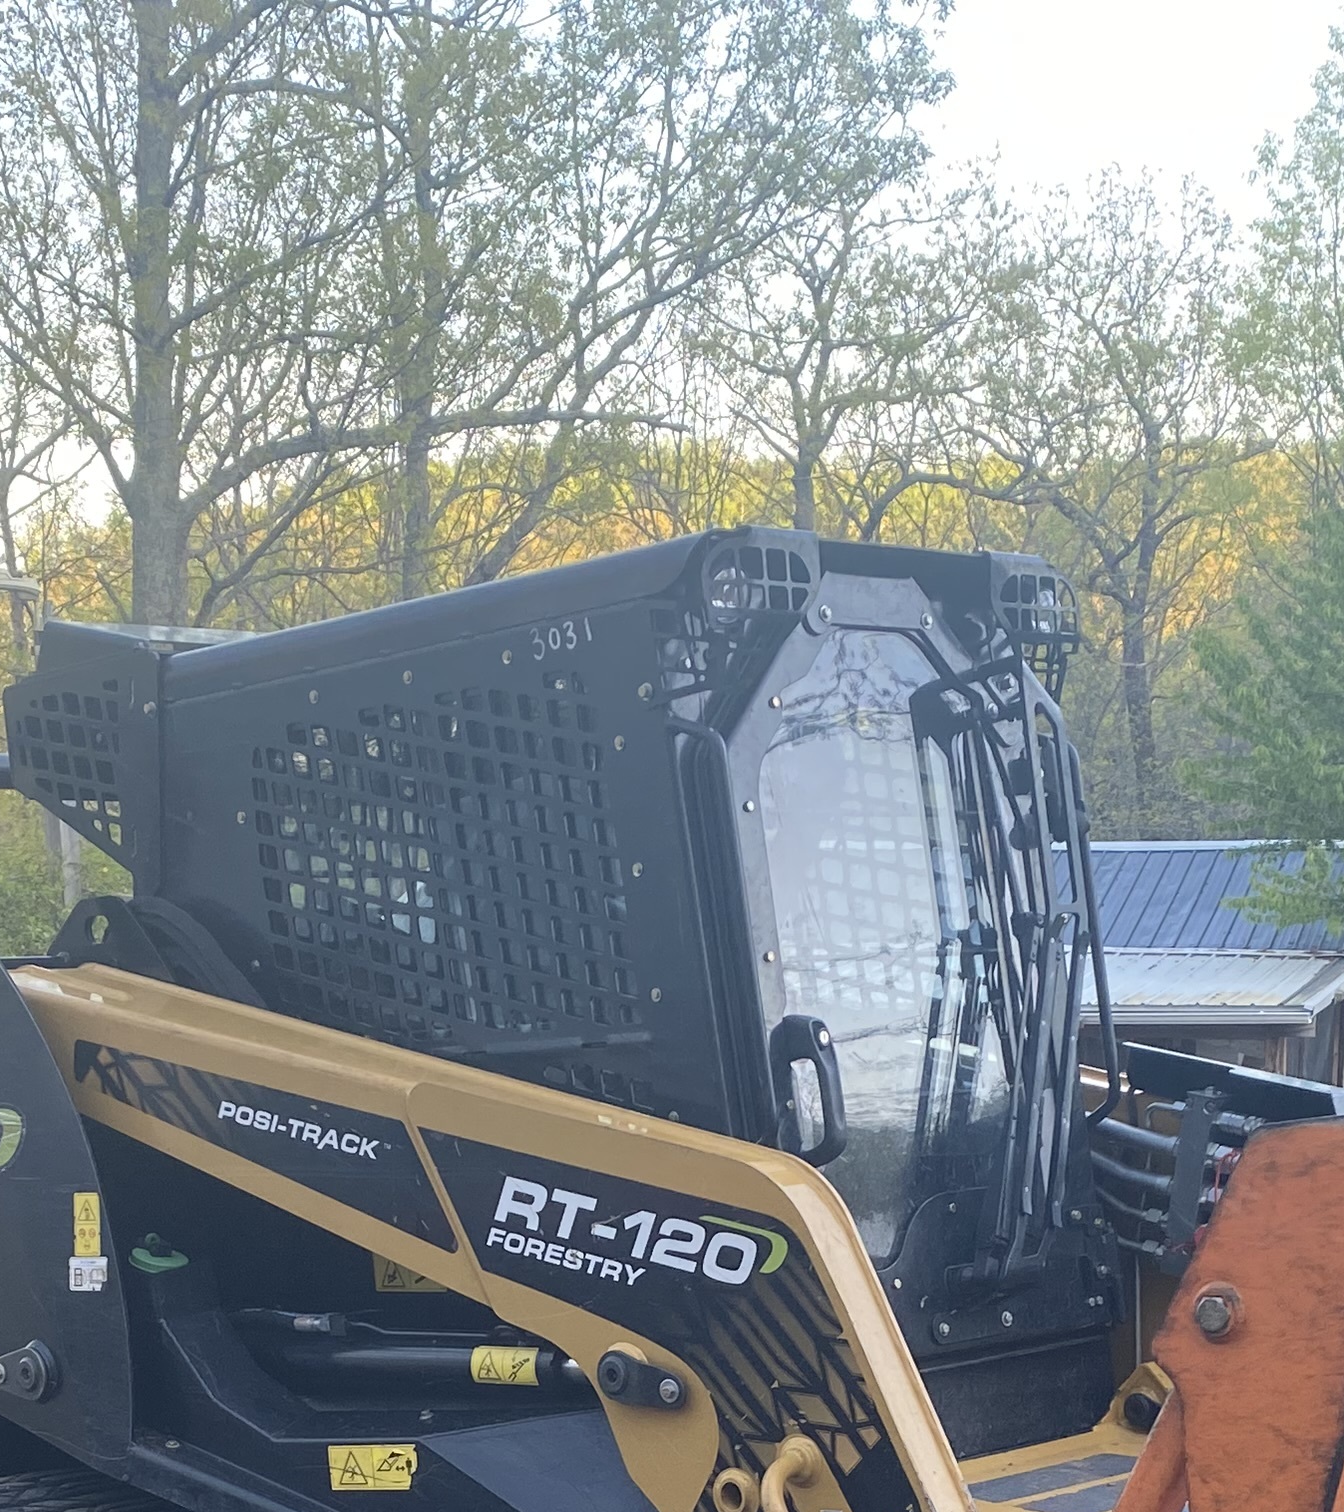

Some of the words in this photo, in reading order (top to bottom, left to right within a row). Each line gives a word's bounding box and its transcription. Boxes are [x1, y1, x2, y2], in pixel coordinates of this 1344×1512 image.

[529, 617, 592, 661] 3031
[217, 1100, 380, 1160] POSI-TRACK
[485, 1227, 647, 1286] FORESTRY
[493, 1175, 758, 1285] RT-120
